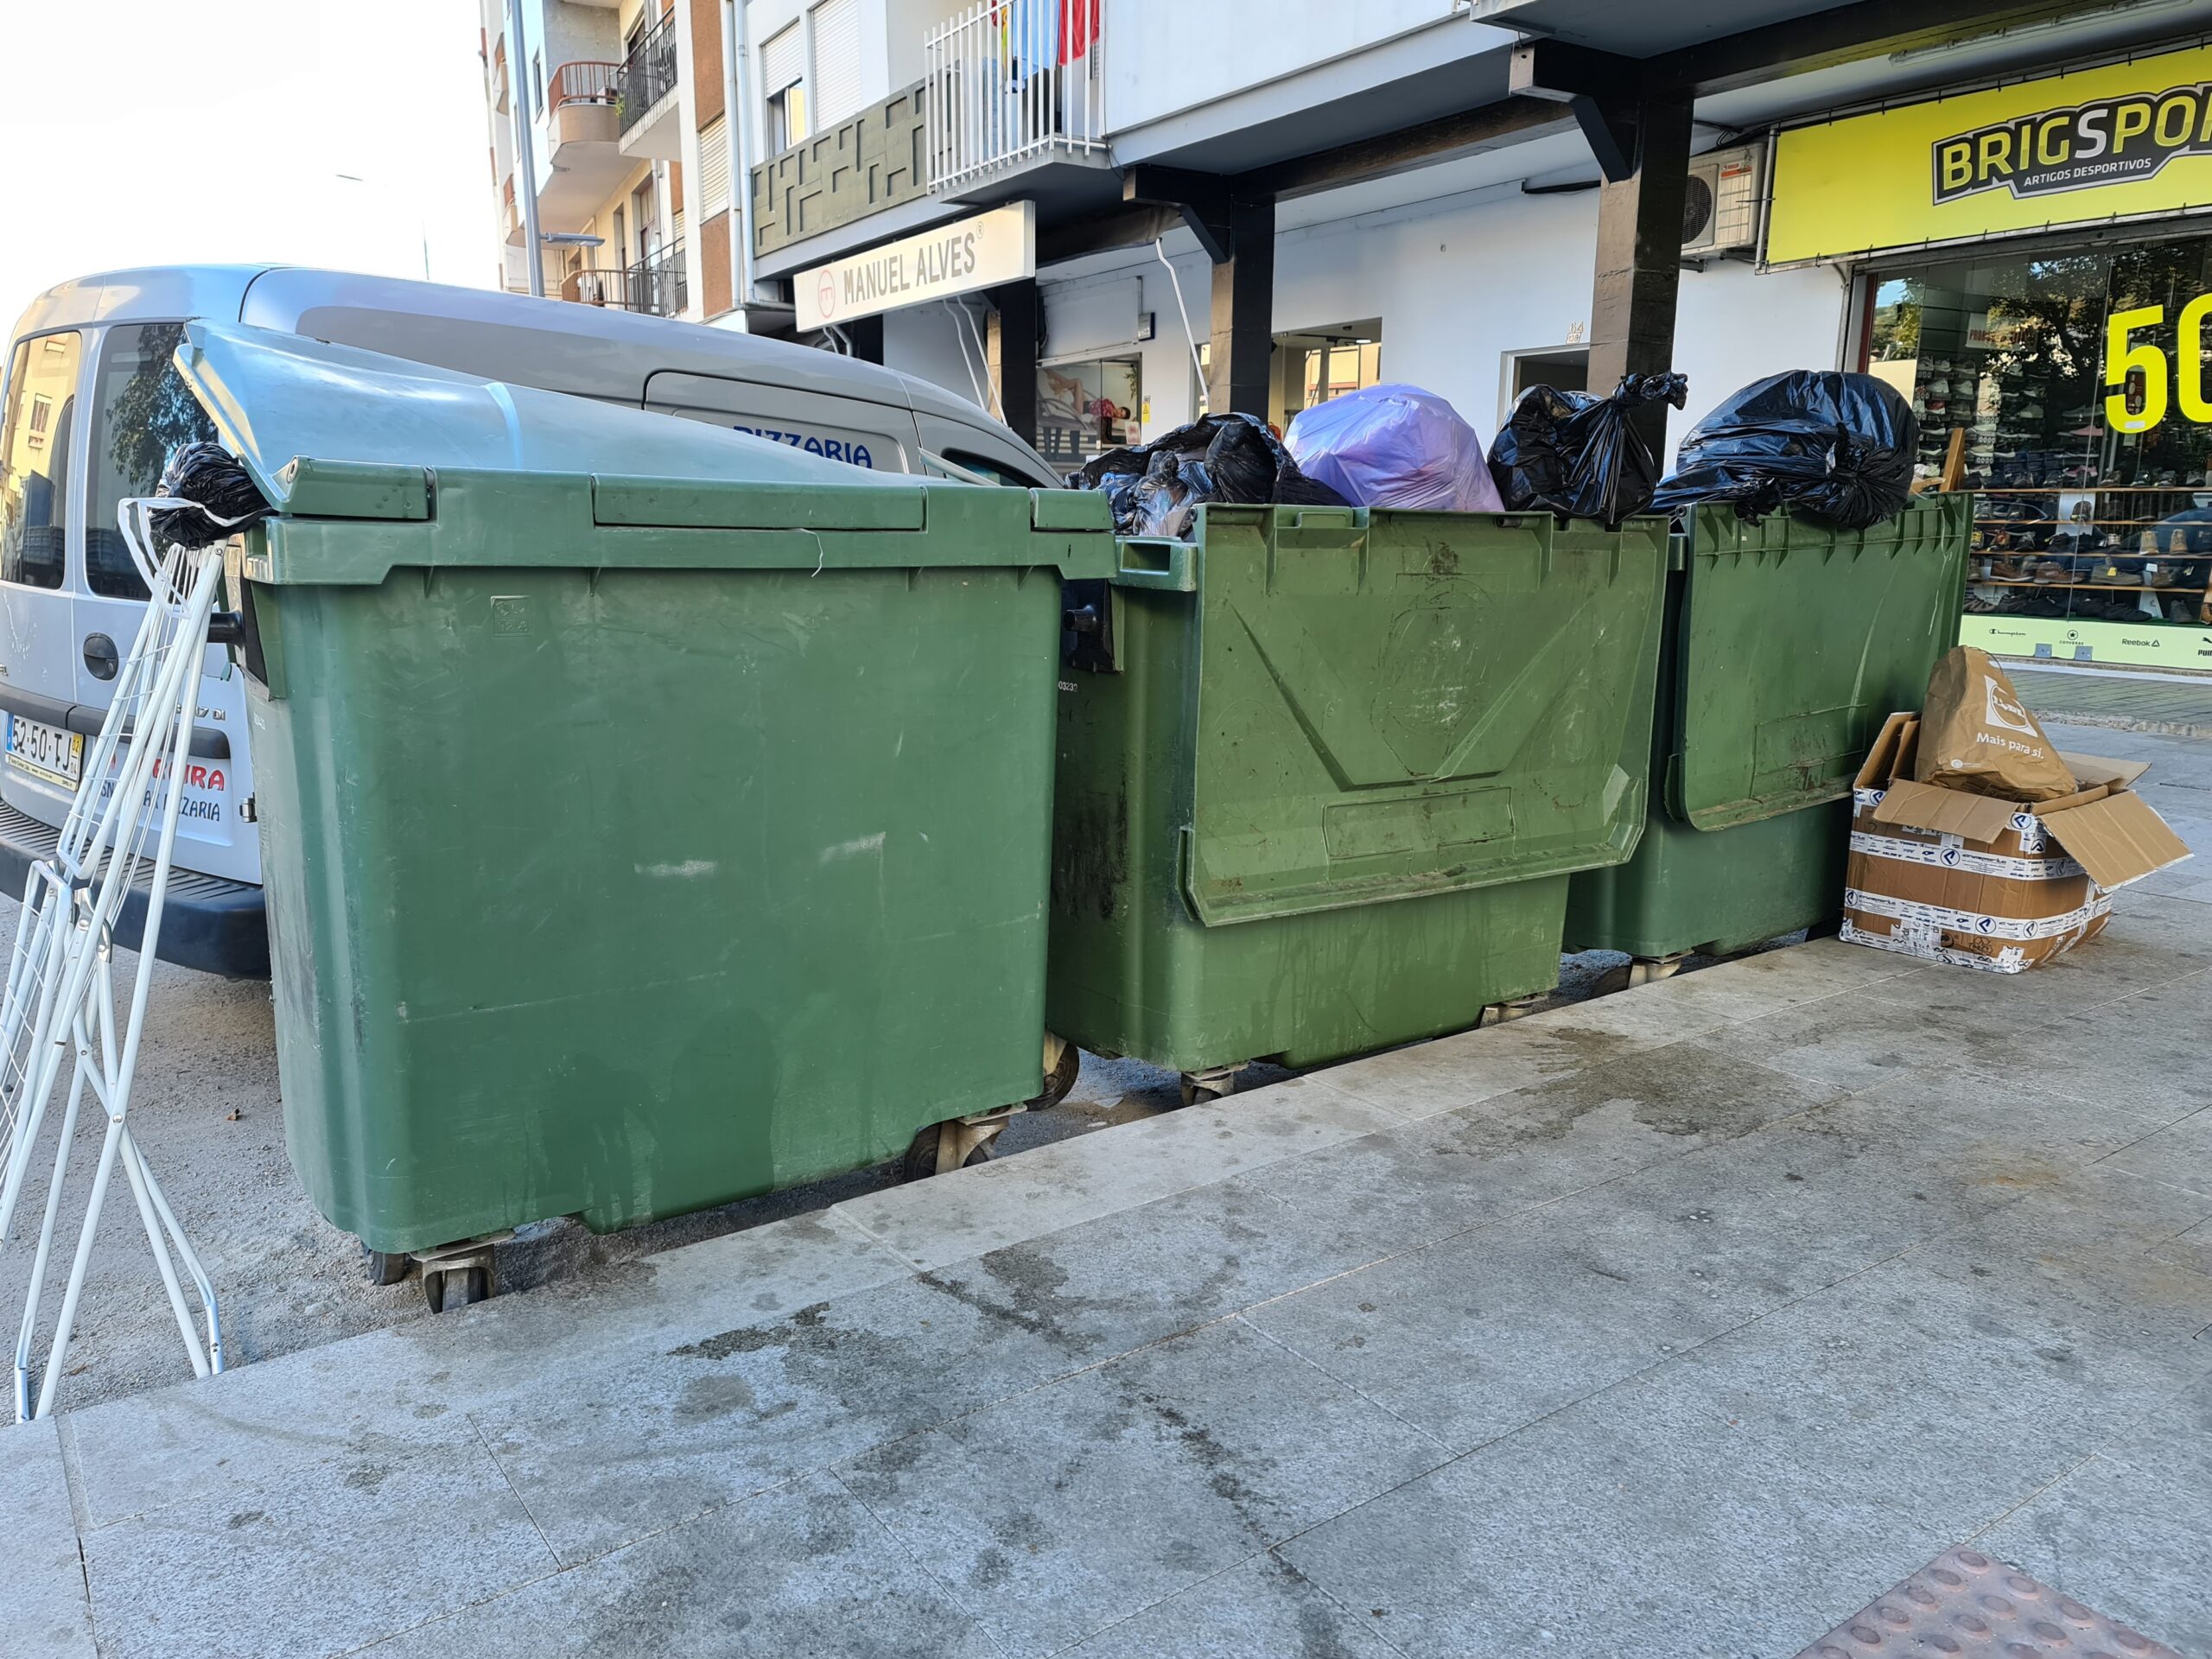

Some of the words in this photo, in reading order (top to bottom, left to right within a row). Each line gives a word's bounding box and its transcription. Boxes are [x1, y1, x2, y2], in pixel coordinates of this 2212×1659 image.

[2024, 169, 2071, 188] ARTIGOS
[2073, 158, 2152, 179] DESPORTIVOS
[843, 254, 910, 305] MANUEL
[916, 232, 976, 288] ALVES
[733, 426, 873, 469] ZARIA
[2121, 638, 2151, 647] Reebok
[1976, 732, 2006, 747] Mais
[2008, 740, 2031, 755] para
[2031, 747, 2044, 760] si.
